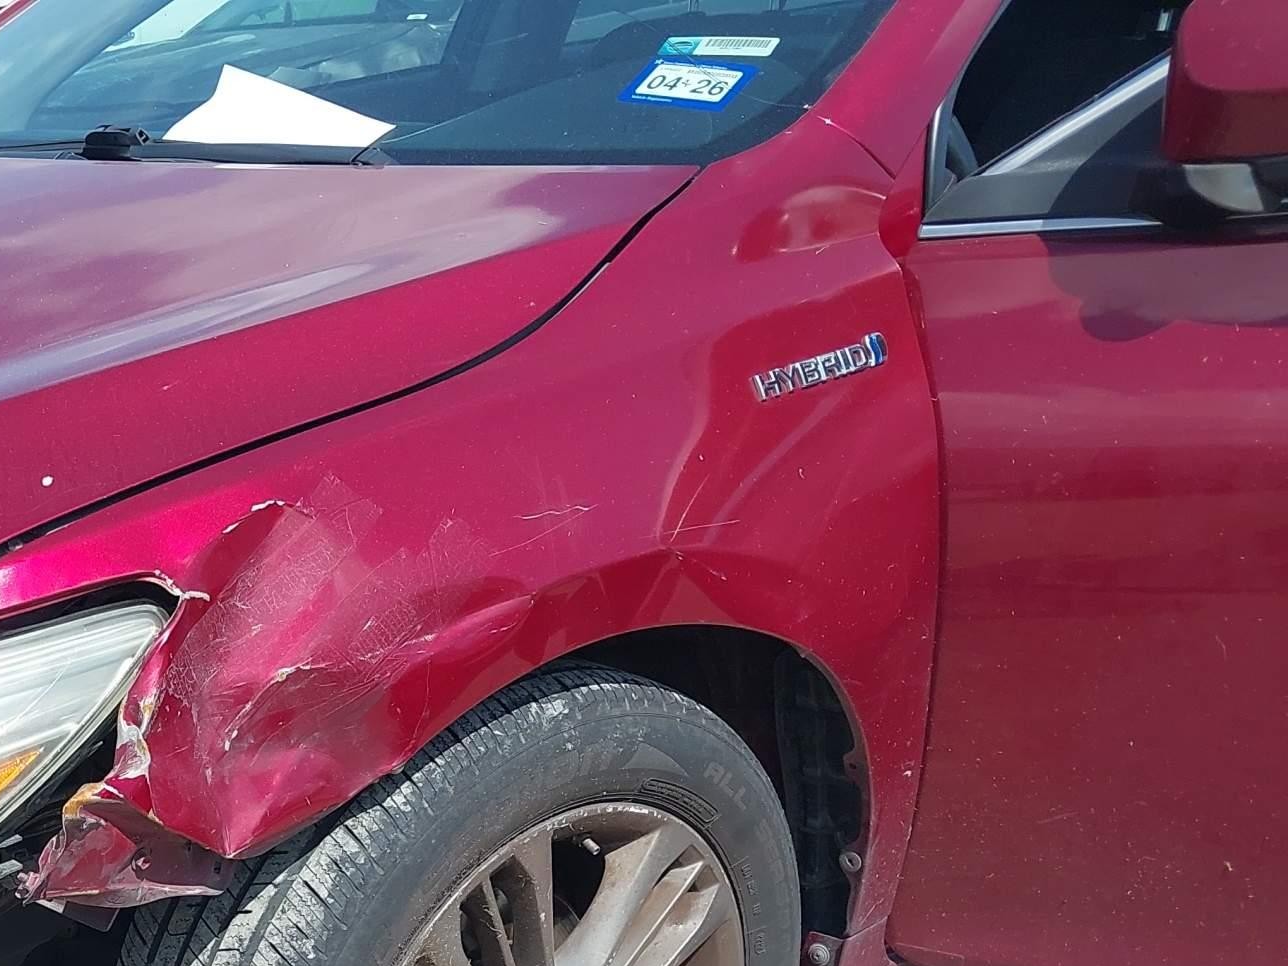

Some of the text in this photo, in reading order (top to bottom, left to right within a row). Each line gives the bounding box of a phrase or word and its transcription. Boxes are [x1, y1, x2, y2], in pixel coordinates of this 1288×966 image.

[646, 74, 729, 97] 04 26
[749, 343, 870, 402] HYBRID
[704, 760, 748, 810] ALL
